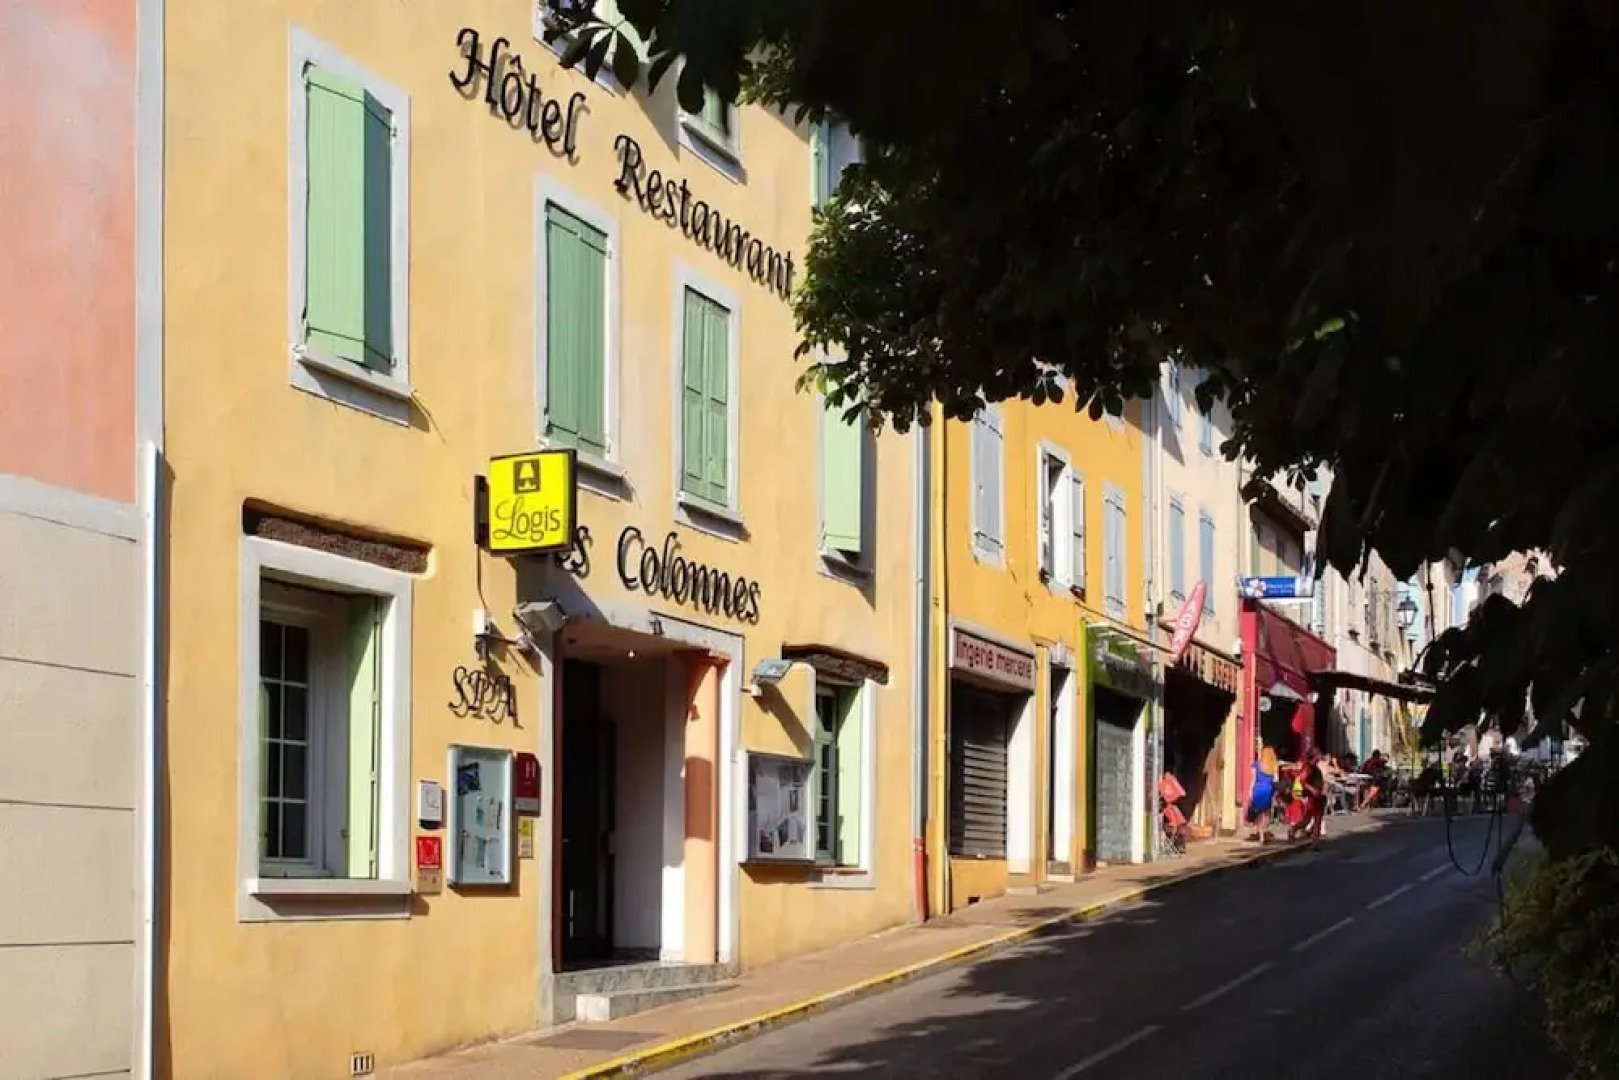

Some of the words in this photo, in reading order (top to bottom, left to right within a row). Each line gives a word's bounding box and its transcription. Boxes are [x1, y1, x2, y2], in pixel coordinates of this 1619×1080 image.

[449, 28, 587, 158] Hôtel
[613, 133, 797, 298] Restaurant
[492, 496, 561, 542] Logis
[617, 526, 760, 621] Colonnes
[448, 665, 521, 727] SPA
